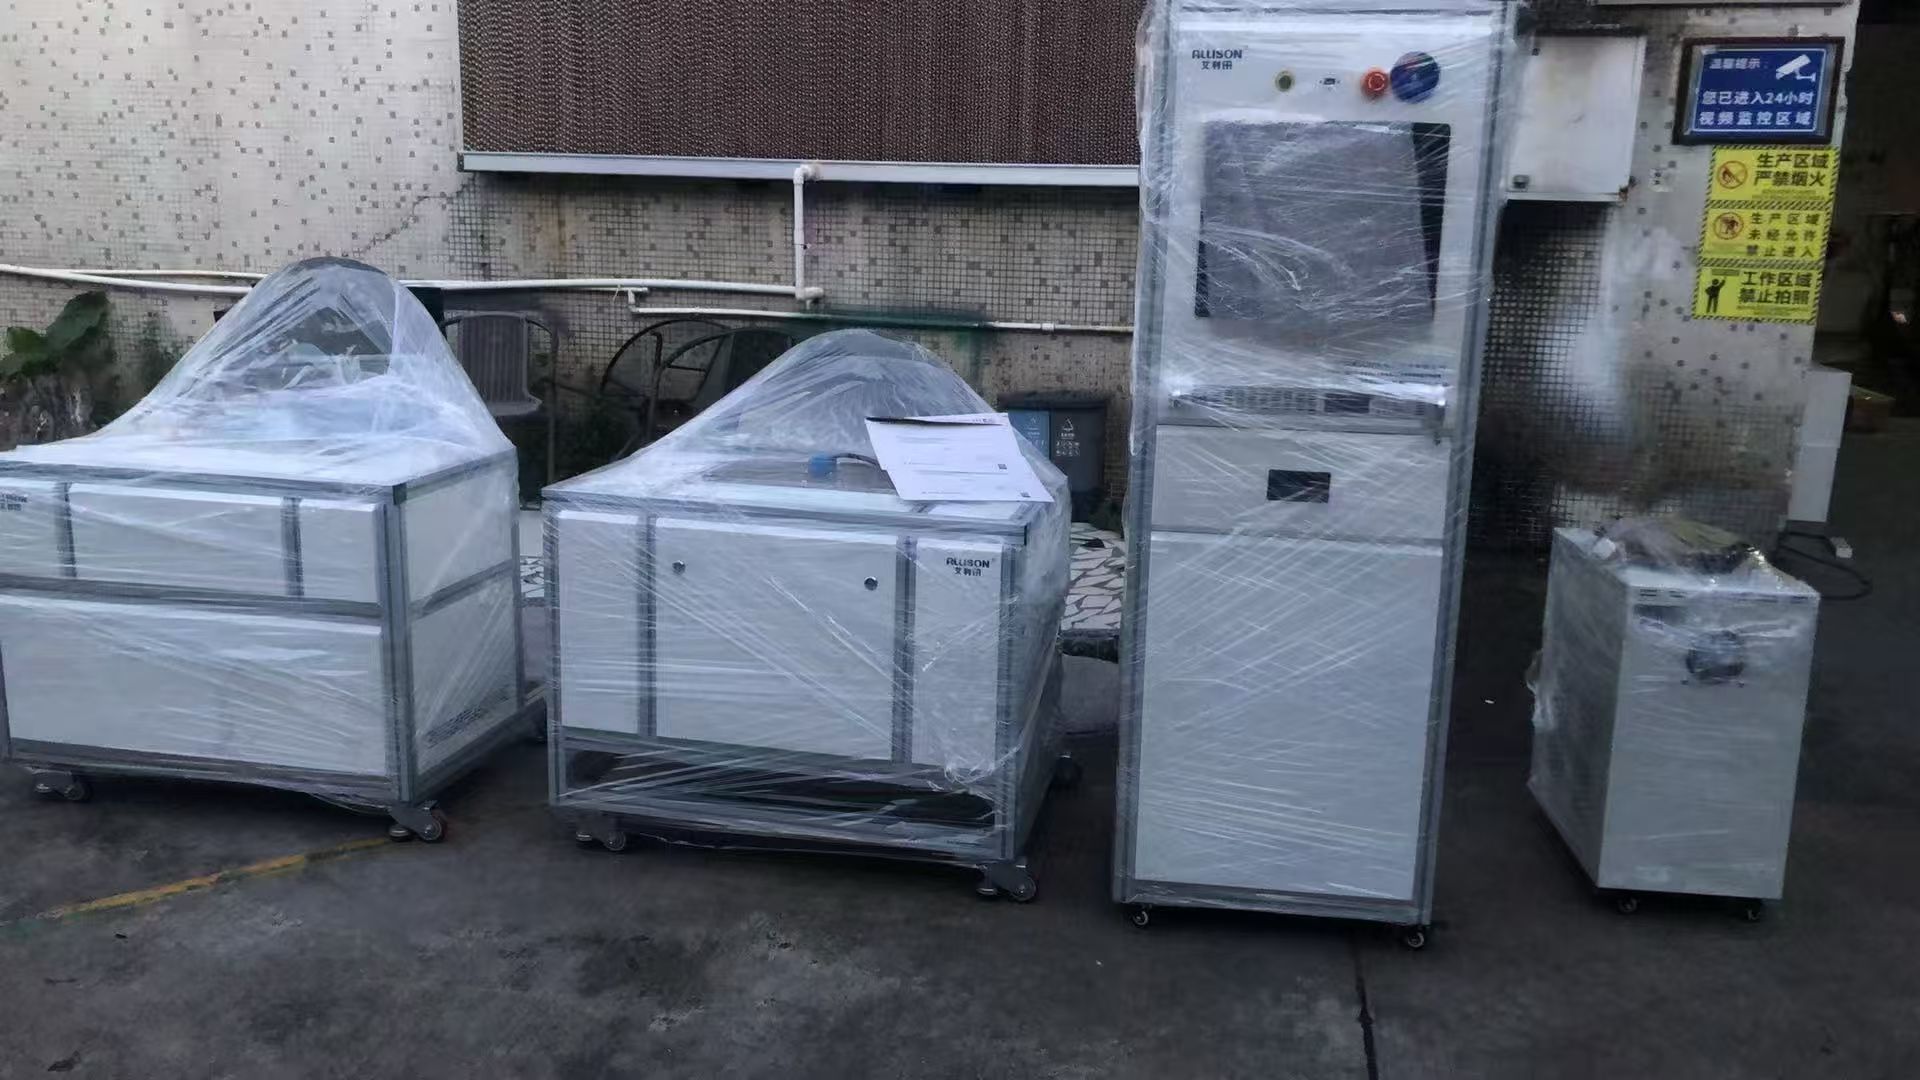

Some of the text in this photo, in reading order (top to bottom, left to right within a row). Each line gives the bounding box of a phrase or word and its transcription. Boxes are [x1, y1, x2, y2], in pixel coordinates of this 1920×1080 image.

[1192, 49, 1243, 59] ALLISON
[1702, 91, 1814, 105] 您已进入24小时
[1700, 111, 1811, 125] 视频监控区域
[1757, 152, 1829, 168] 生产区域
[1754, 170, 1825, 186] 严禁烟火
[1751, 213, 1820, 225] 生产区域
[1748, 229, 1817, 241] 未经允许
[1746, 244, 1814, 257] 禁止进入
[1741, 271, 1812, 287] 工作区域
[1739, 288, 1810, 304] 禁止拍照
[946, 557, 990, 568] ALLISON
